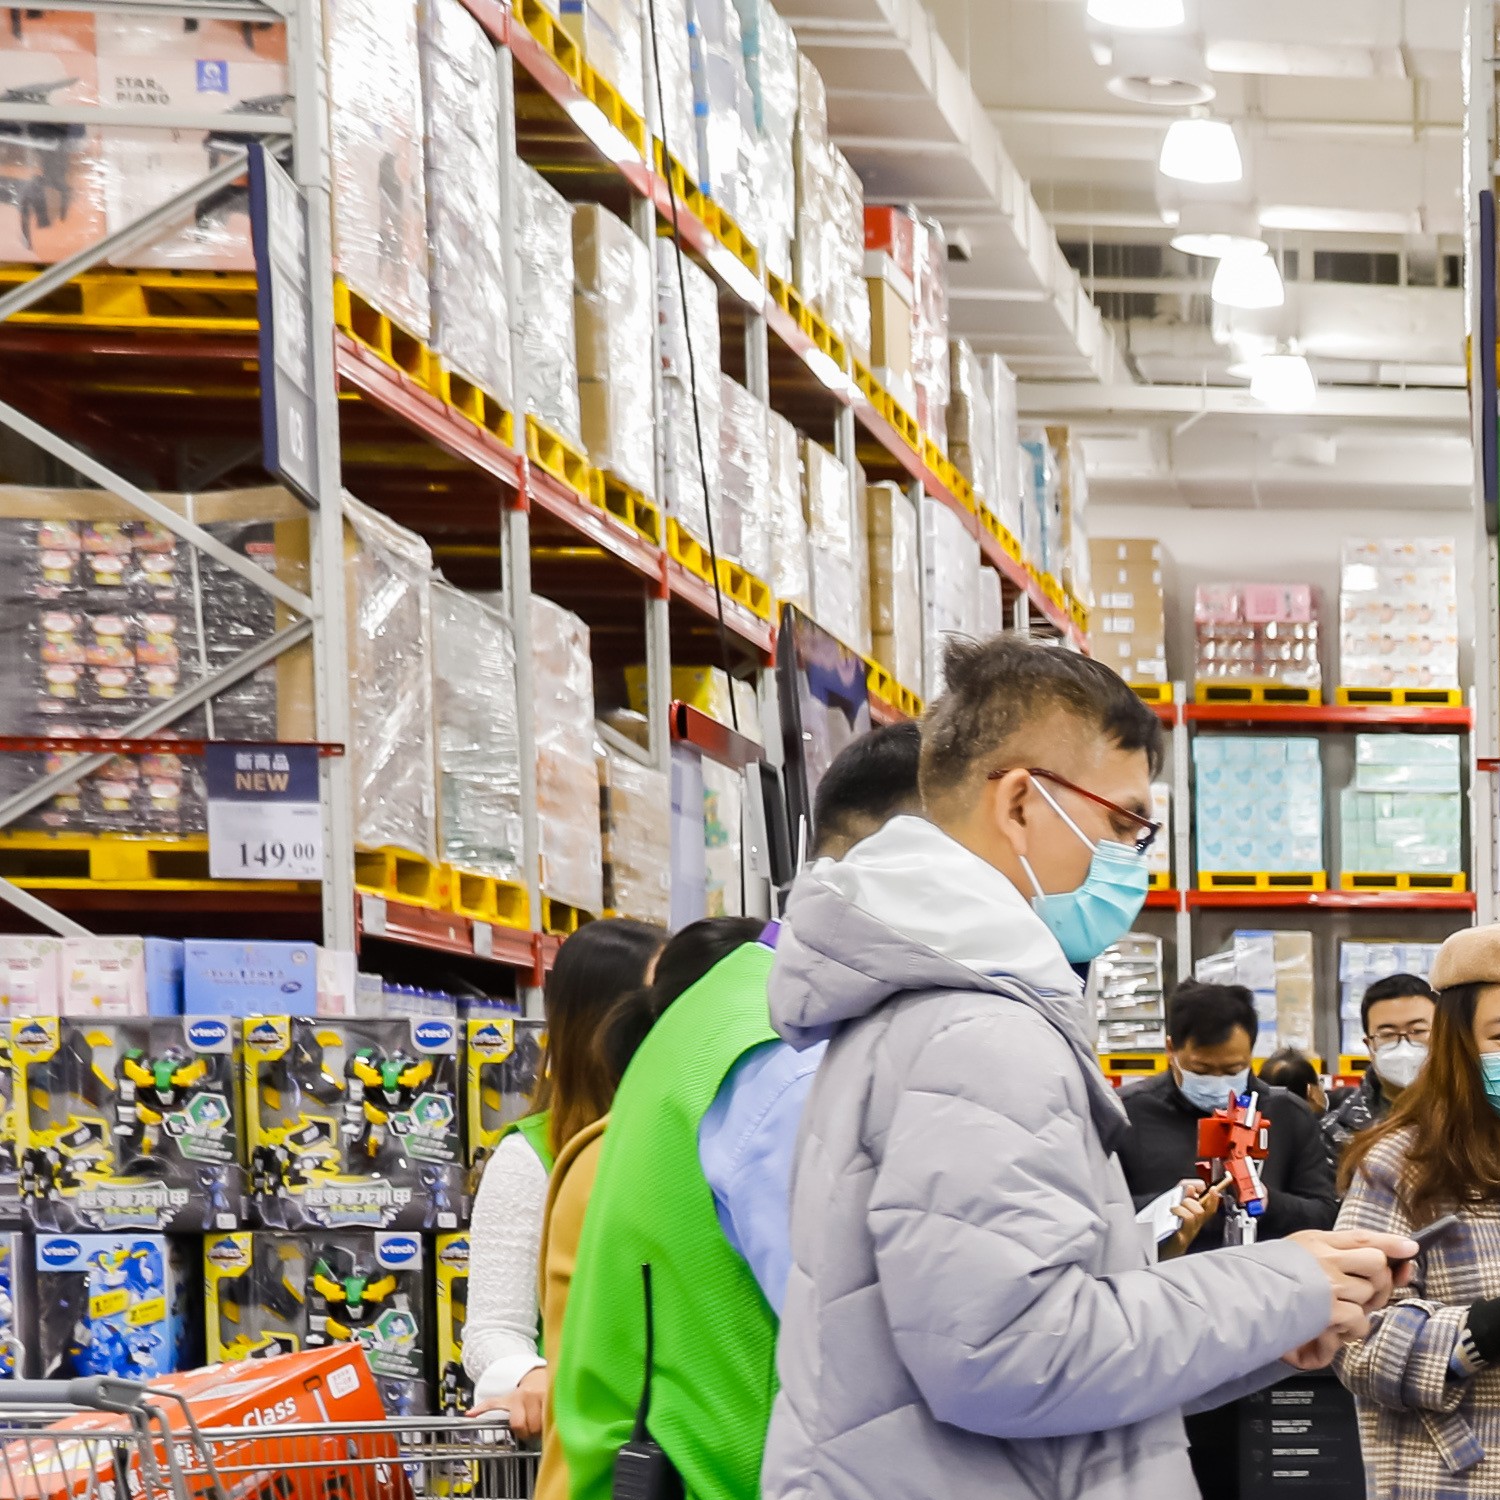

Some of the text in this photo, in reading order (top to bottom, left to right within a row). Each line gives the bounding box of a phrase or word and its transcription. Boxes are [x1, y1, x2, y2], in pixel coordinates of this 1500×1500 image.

[234, 773, 290, 792] NEW
[240, 842, 316, 869] 149.00
[189, 1024, 227, 1042] vtech
[415, 1024, 453, 1042] vtech
[41, 1243, 81, 1262] vtech
[379, 1243, 417, 1262] vtech
[242, 1396, 297, 1428] Class
